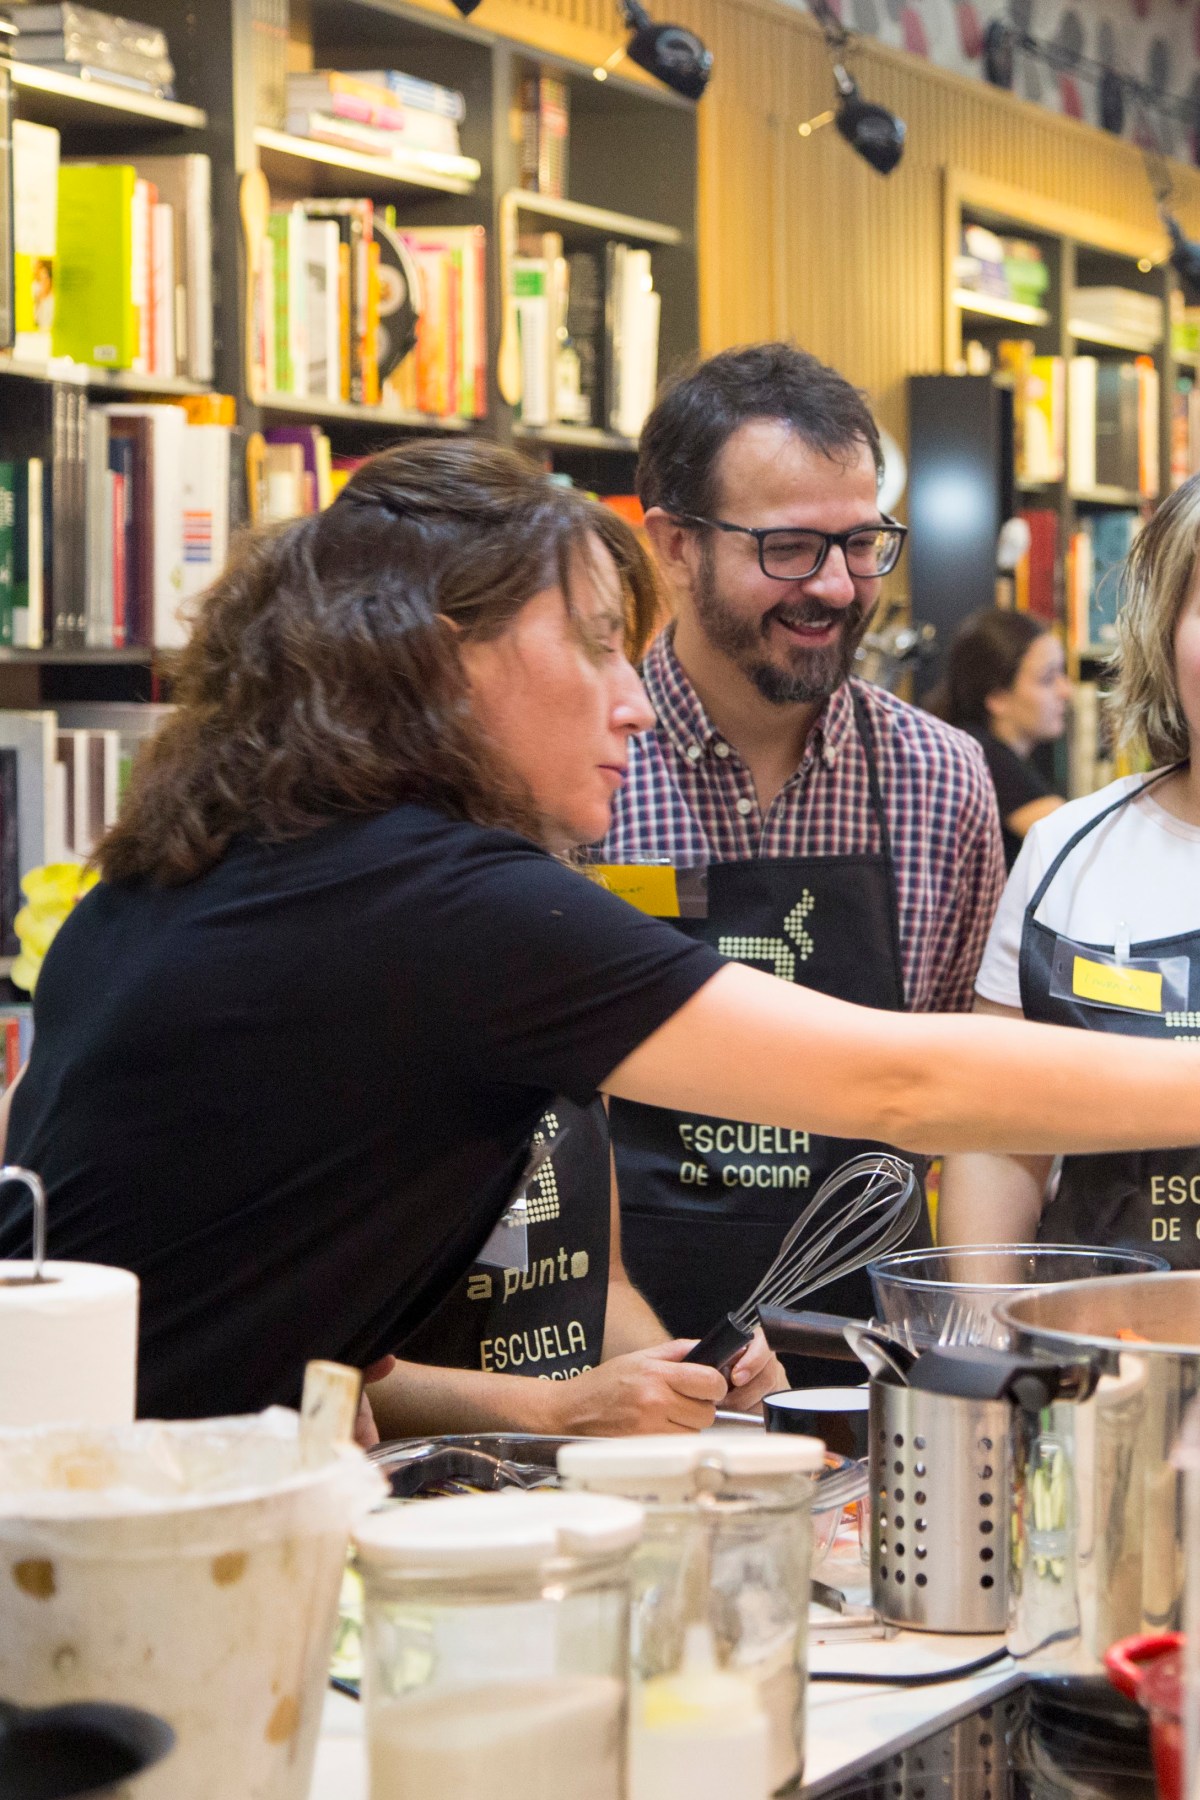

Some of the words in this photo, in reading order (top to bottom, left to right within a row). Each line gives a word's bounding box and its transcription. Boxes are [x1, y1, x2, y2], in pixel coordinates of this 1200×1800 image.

[679, 1123, 811, 1154] ESCUELA
[680, 1161, 710, 1186] DE
[721, 1164, 811, 1188] COCINA
[1151, 1217, 1181, 1242] DE
[466, 1273, 492, 1301] a
[502, 1246, 589, 1304] punto
[479, 1320, 587, 1373] ESCUELA
